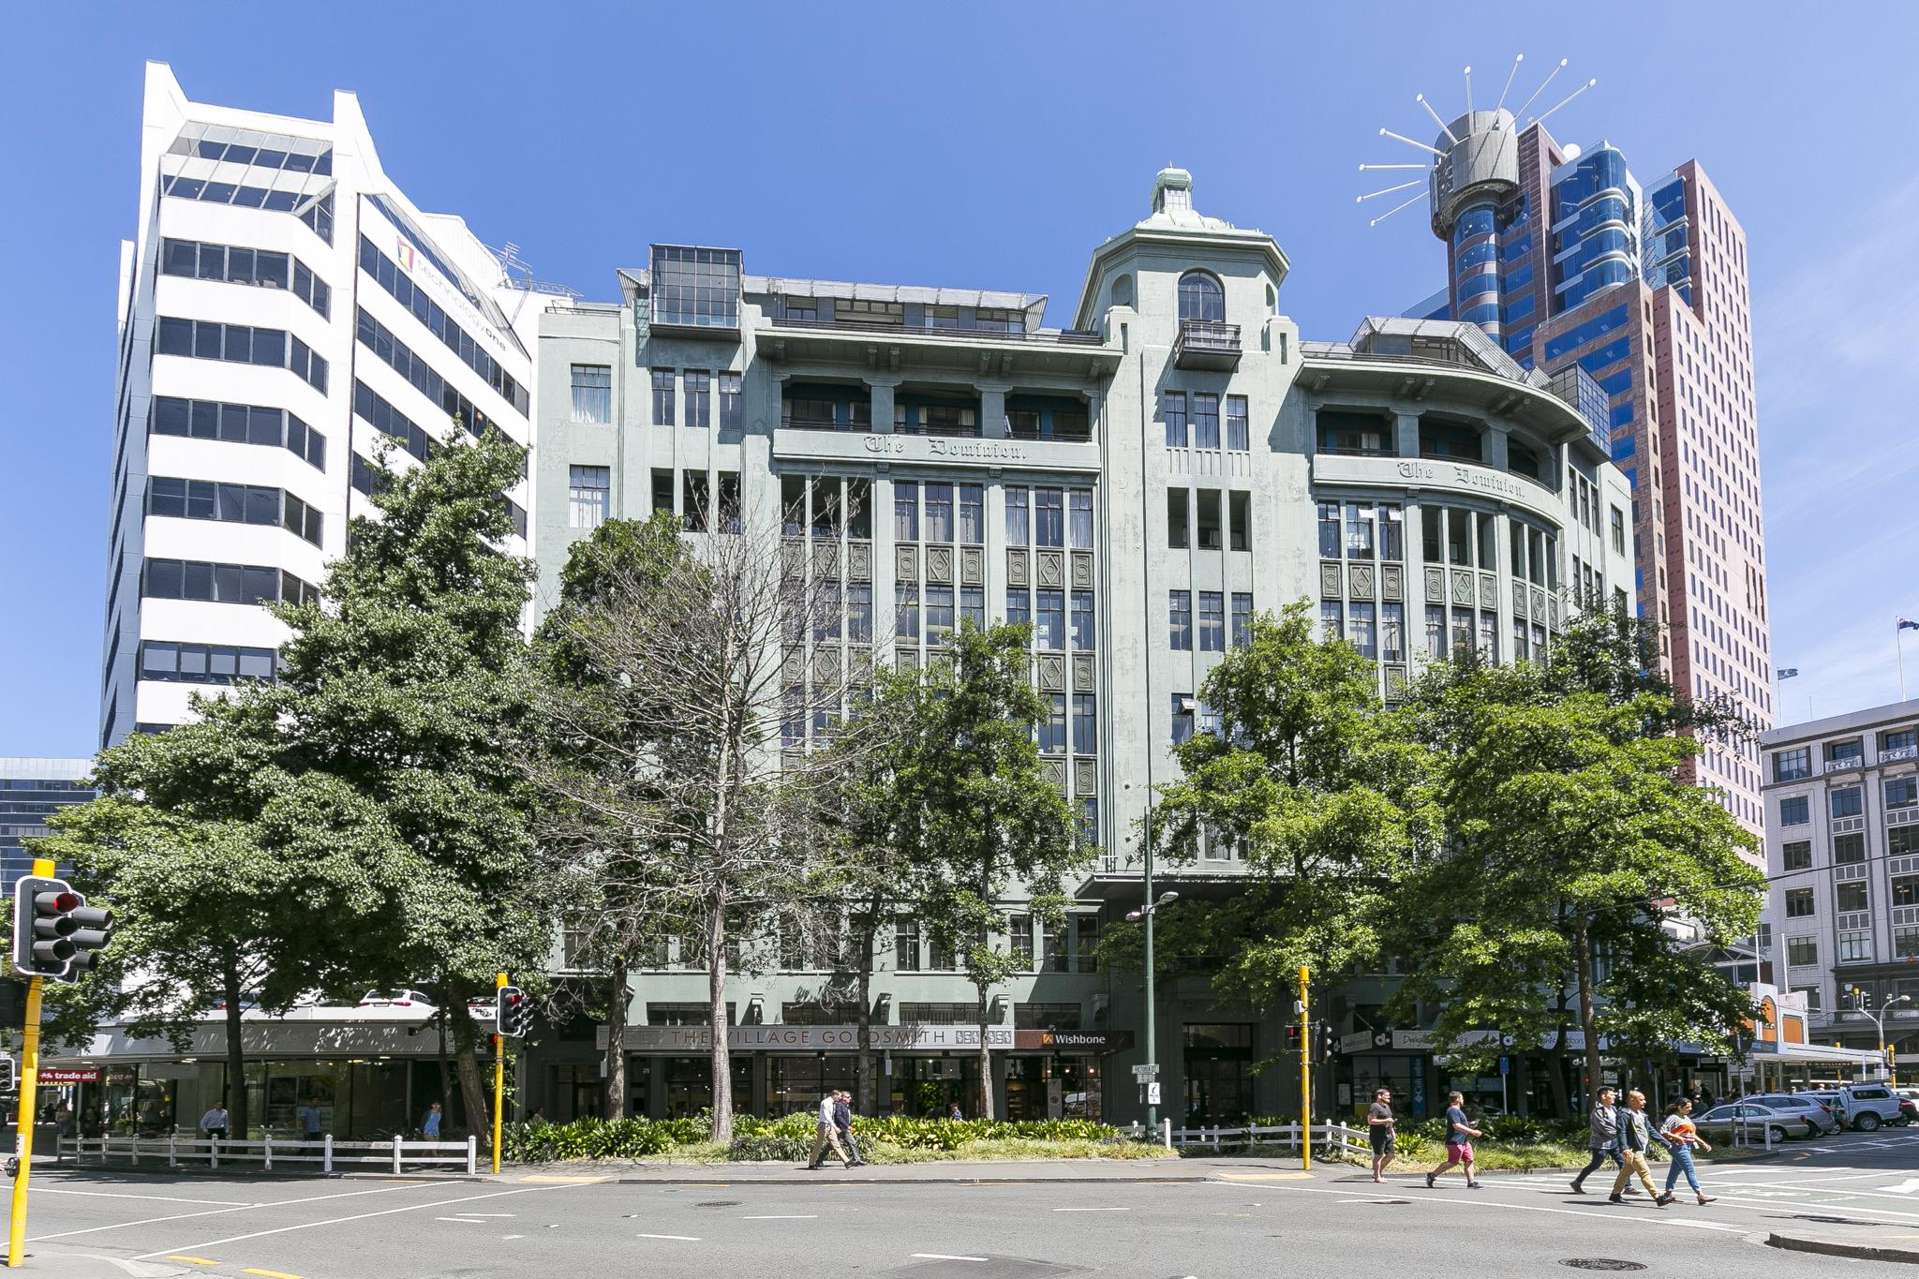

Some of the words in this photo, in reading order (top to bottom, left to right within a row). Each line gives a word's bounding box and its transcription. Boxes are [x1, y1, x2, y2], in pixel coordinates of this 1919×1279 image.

[864, 435, 904, 454] The
[1397, 462, 1433, 479] The
[672, 1031, 708, 1044] THE
[822, 1030, 946, 1044] GODSMITH
[1055, 1034, 1106, 1044] Wishbone
[54, 1071, 81, 1080] trade
[81, 1071, 97, 1080] aid
